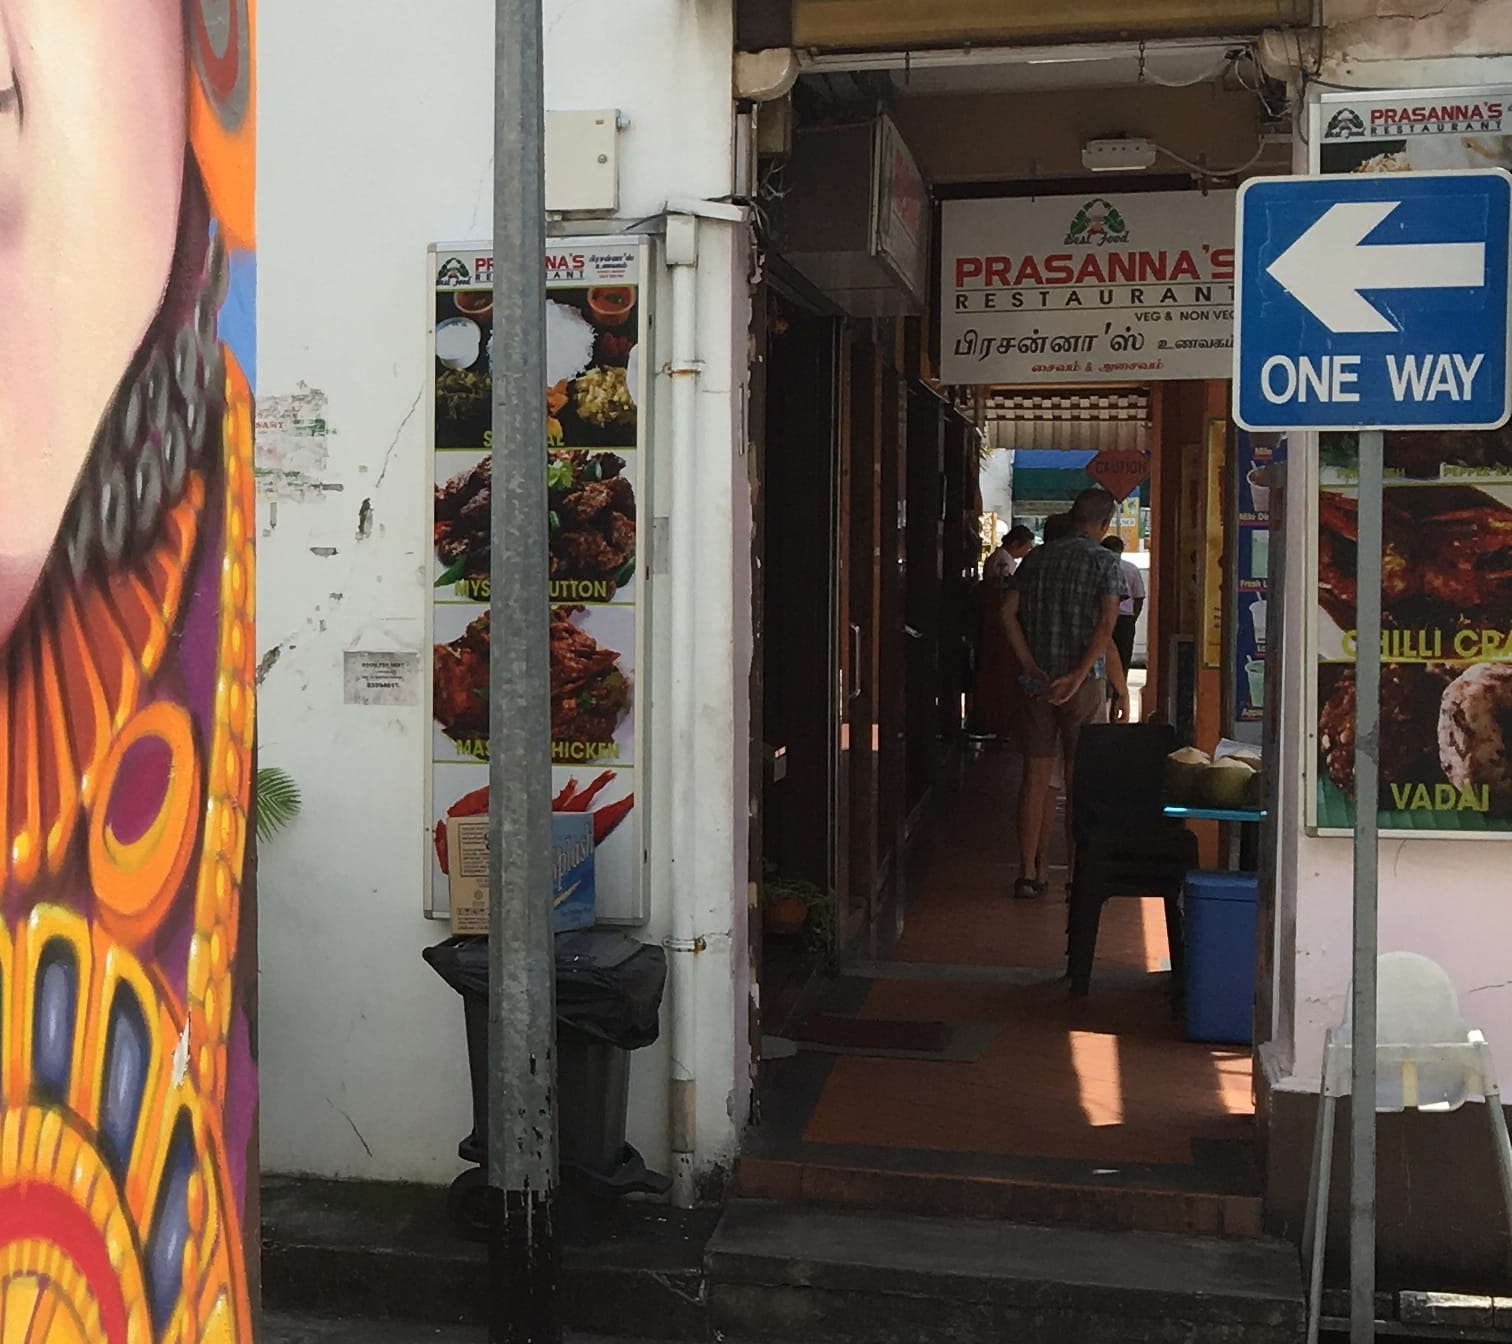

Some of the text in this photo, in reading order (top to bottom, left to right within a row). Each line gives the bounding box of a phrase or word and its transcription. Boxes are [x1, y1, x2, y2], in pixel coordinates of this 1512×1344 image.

[1370, 101, 1503, 125] PRASANNA'S
[1370, 120, 1502, 135] RESTAURANT
[955, 244, 1235, 288] PRASANNA'S
[1134, 312, 1161, 323] VEG
[1164, 312, 1173, 322] &
[1180, 311, 1210, 322] NON
[1261, 353, 1485, 404] ONE WAY
[1095, 460, 1147, 475] CAUTION
[548, 580, 607, 598] UTTON
[552, 741, 620, 759] HICKEN
[1390, 783, 1490, 812] VADAI
